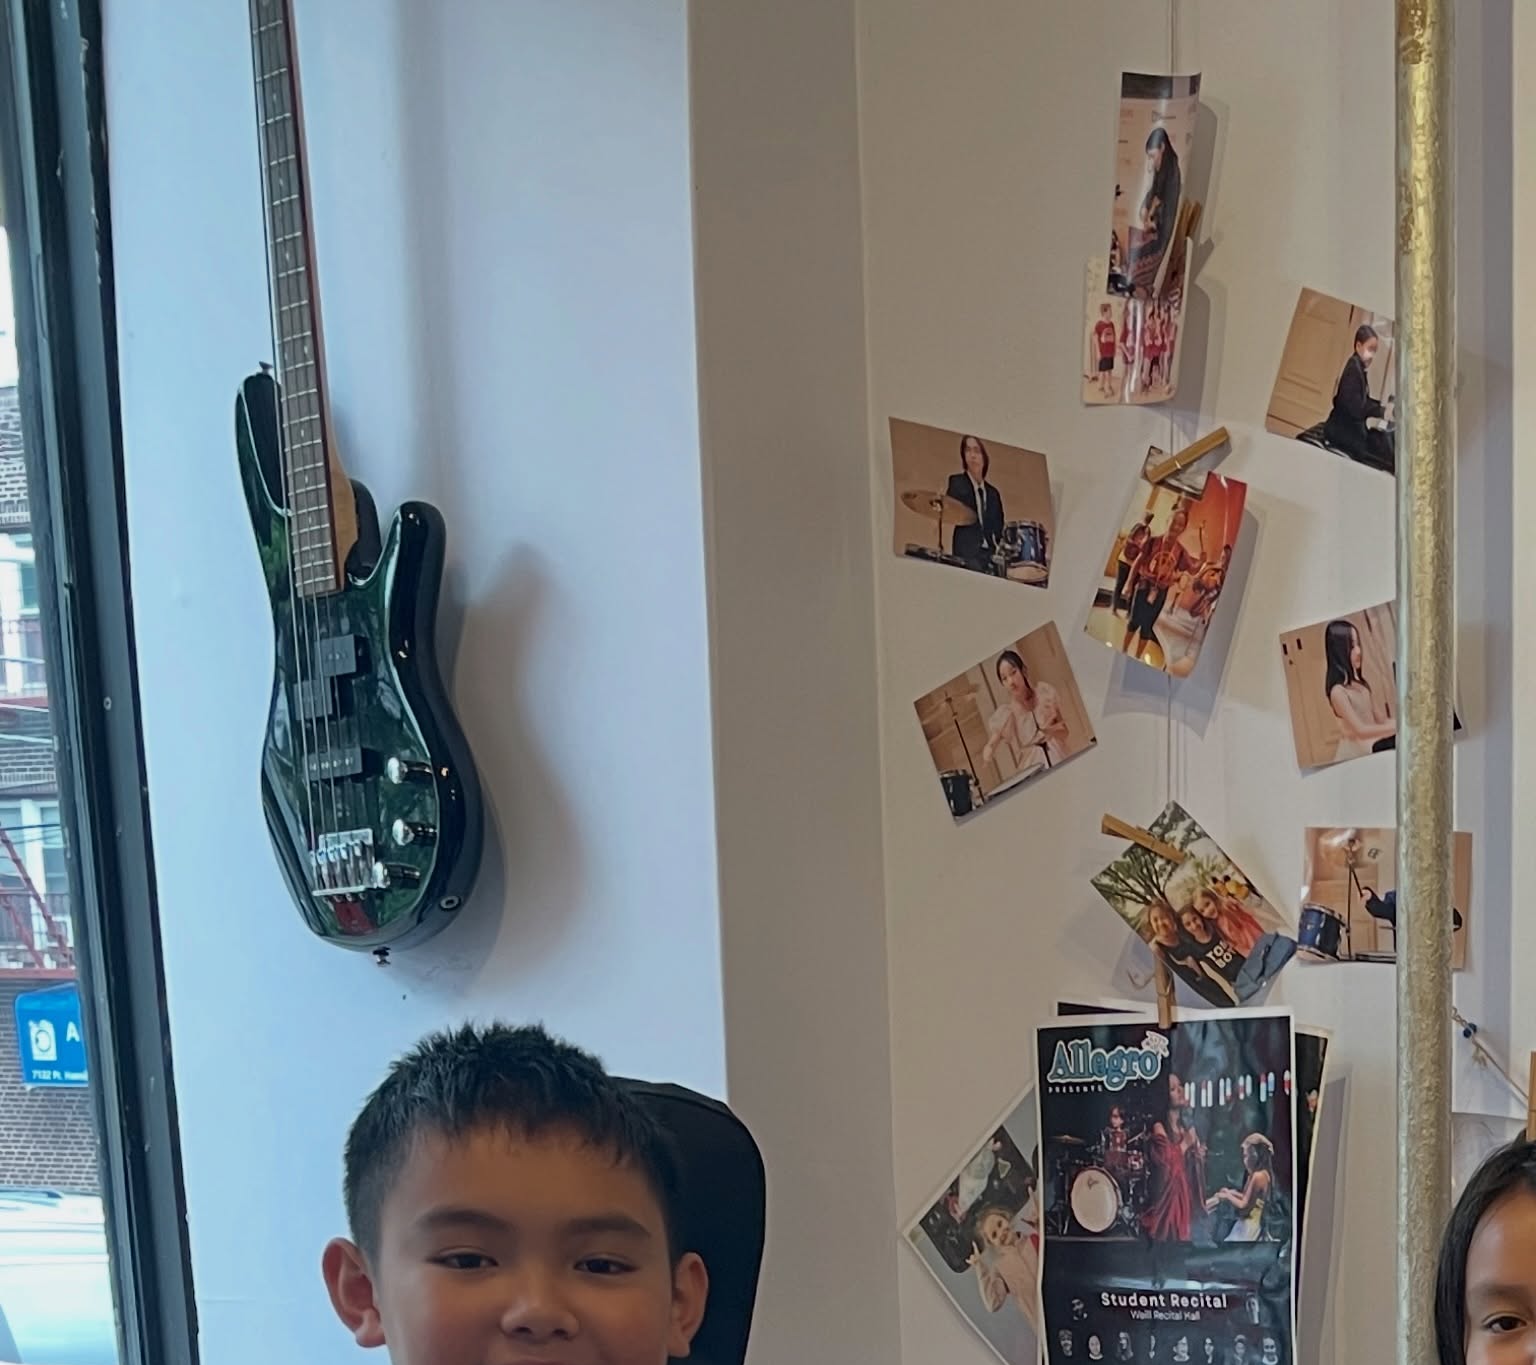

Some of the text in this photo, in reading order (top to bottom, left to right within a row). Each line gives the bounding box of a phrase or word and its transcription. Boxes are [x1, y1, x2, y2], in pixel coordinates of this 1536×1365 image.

[1048, 1039, 1162, 1091] Allegro
[1101, 1292, 1228, 1308] Student Recital
[1153, 1310, 1183, 1321] Recital
